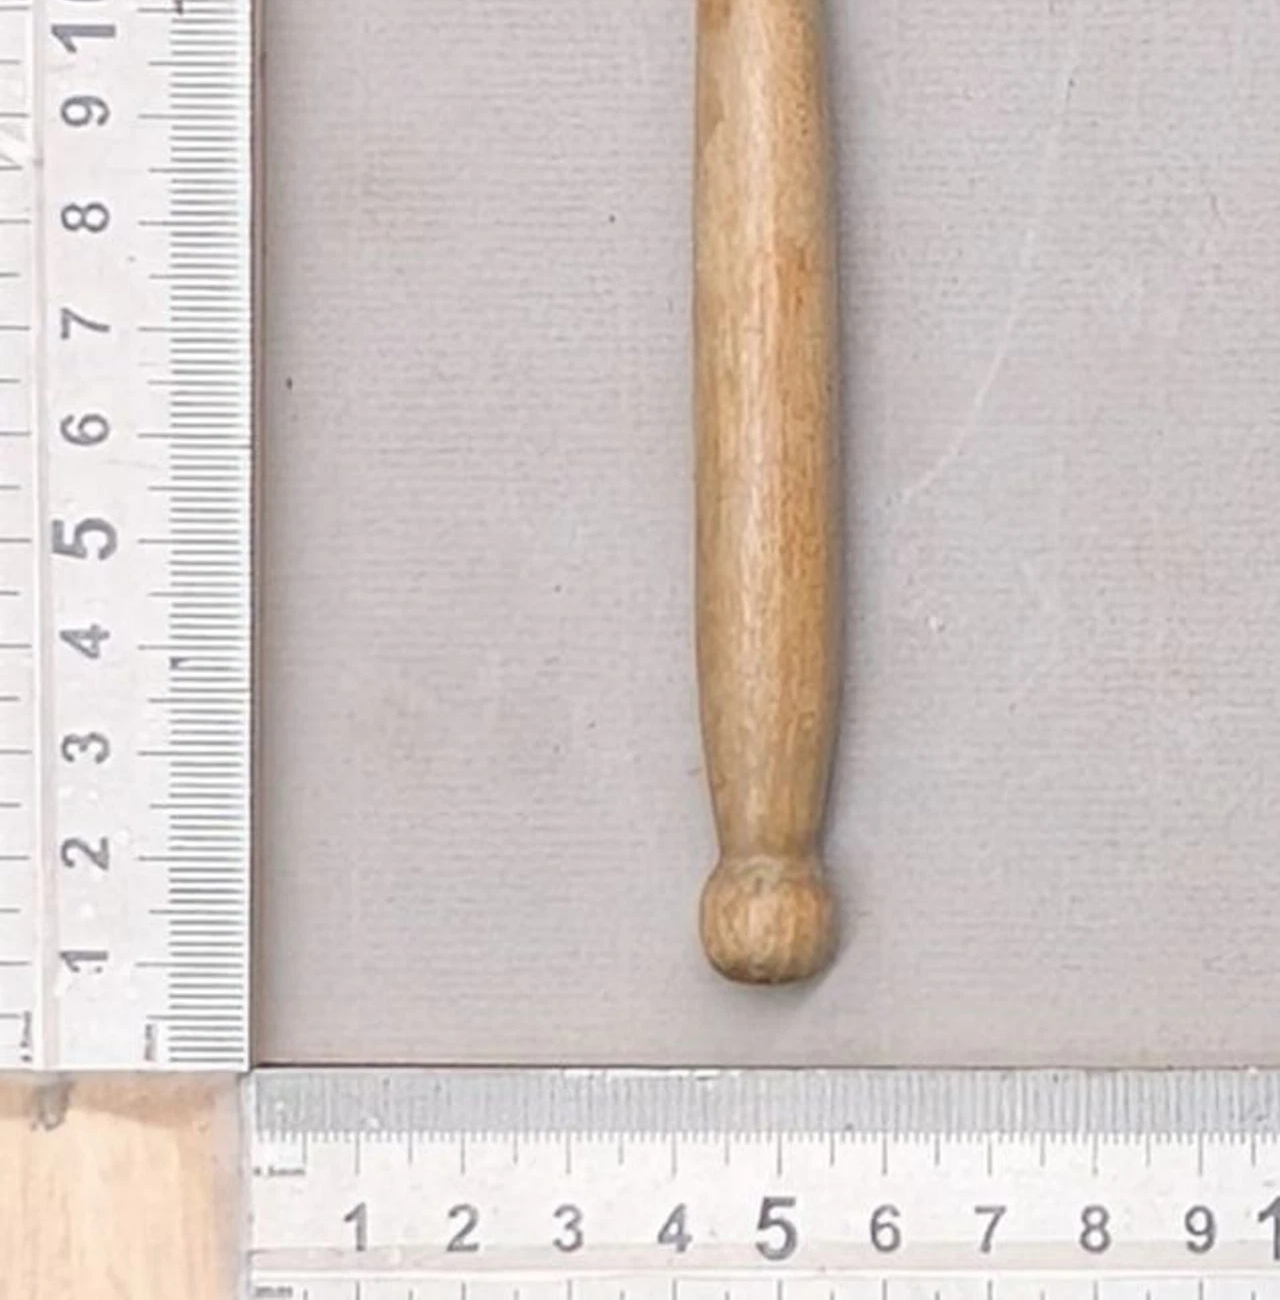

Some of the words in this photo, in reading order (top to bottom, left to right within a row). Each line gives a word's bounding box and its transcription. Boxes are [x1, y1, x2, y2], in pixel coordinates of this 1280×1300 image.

[60, 95, 110, 127] 9
[60, 202, 110, 234] 8
[60, 307, 110, 340] 7
[60, 414, 110, 446] 6
[50, 518, 117, 561] 5
[59, 624, 110, 660] 4
[60, 732, 110, 764] 3
[60, 837, 110, 871] 2
[57, 950, 109, 973] 1
[343, 1202, 366, 1252] 1
[446, 1203, 479, 1253] 2
[553, 1204, 583, 1253] 3
[657, 1203, 692, 1253] 4
[755, 1196, 797, 1261] 5
[869, 1204, 901, 1254] 6
[974, 1205, 1007, 1254] 7
[1079, 1205, 1111, 1254] 8
[1184, 1205, 1216, 1254] 9
